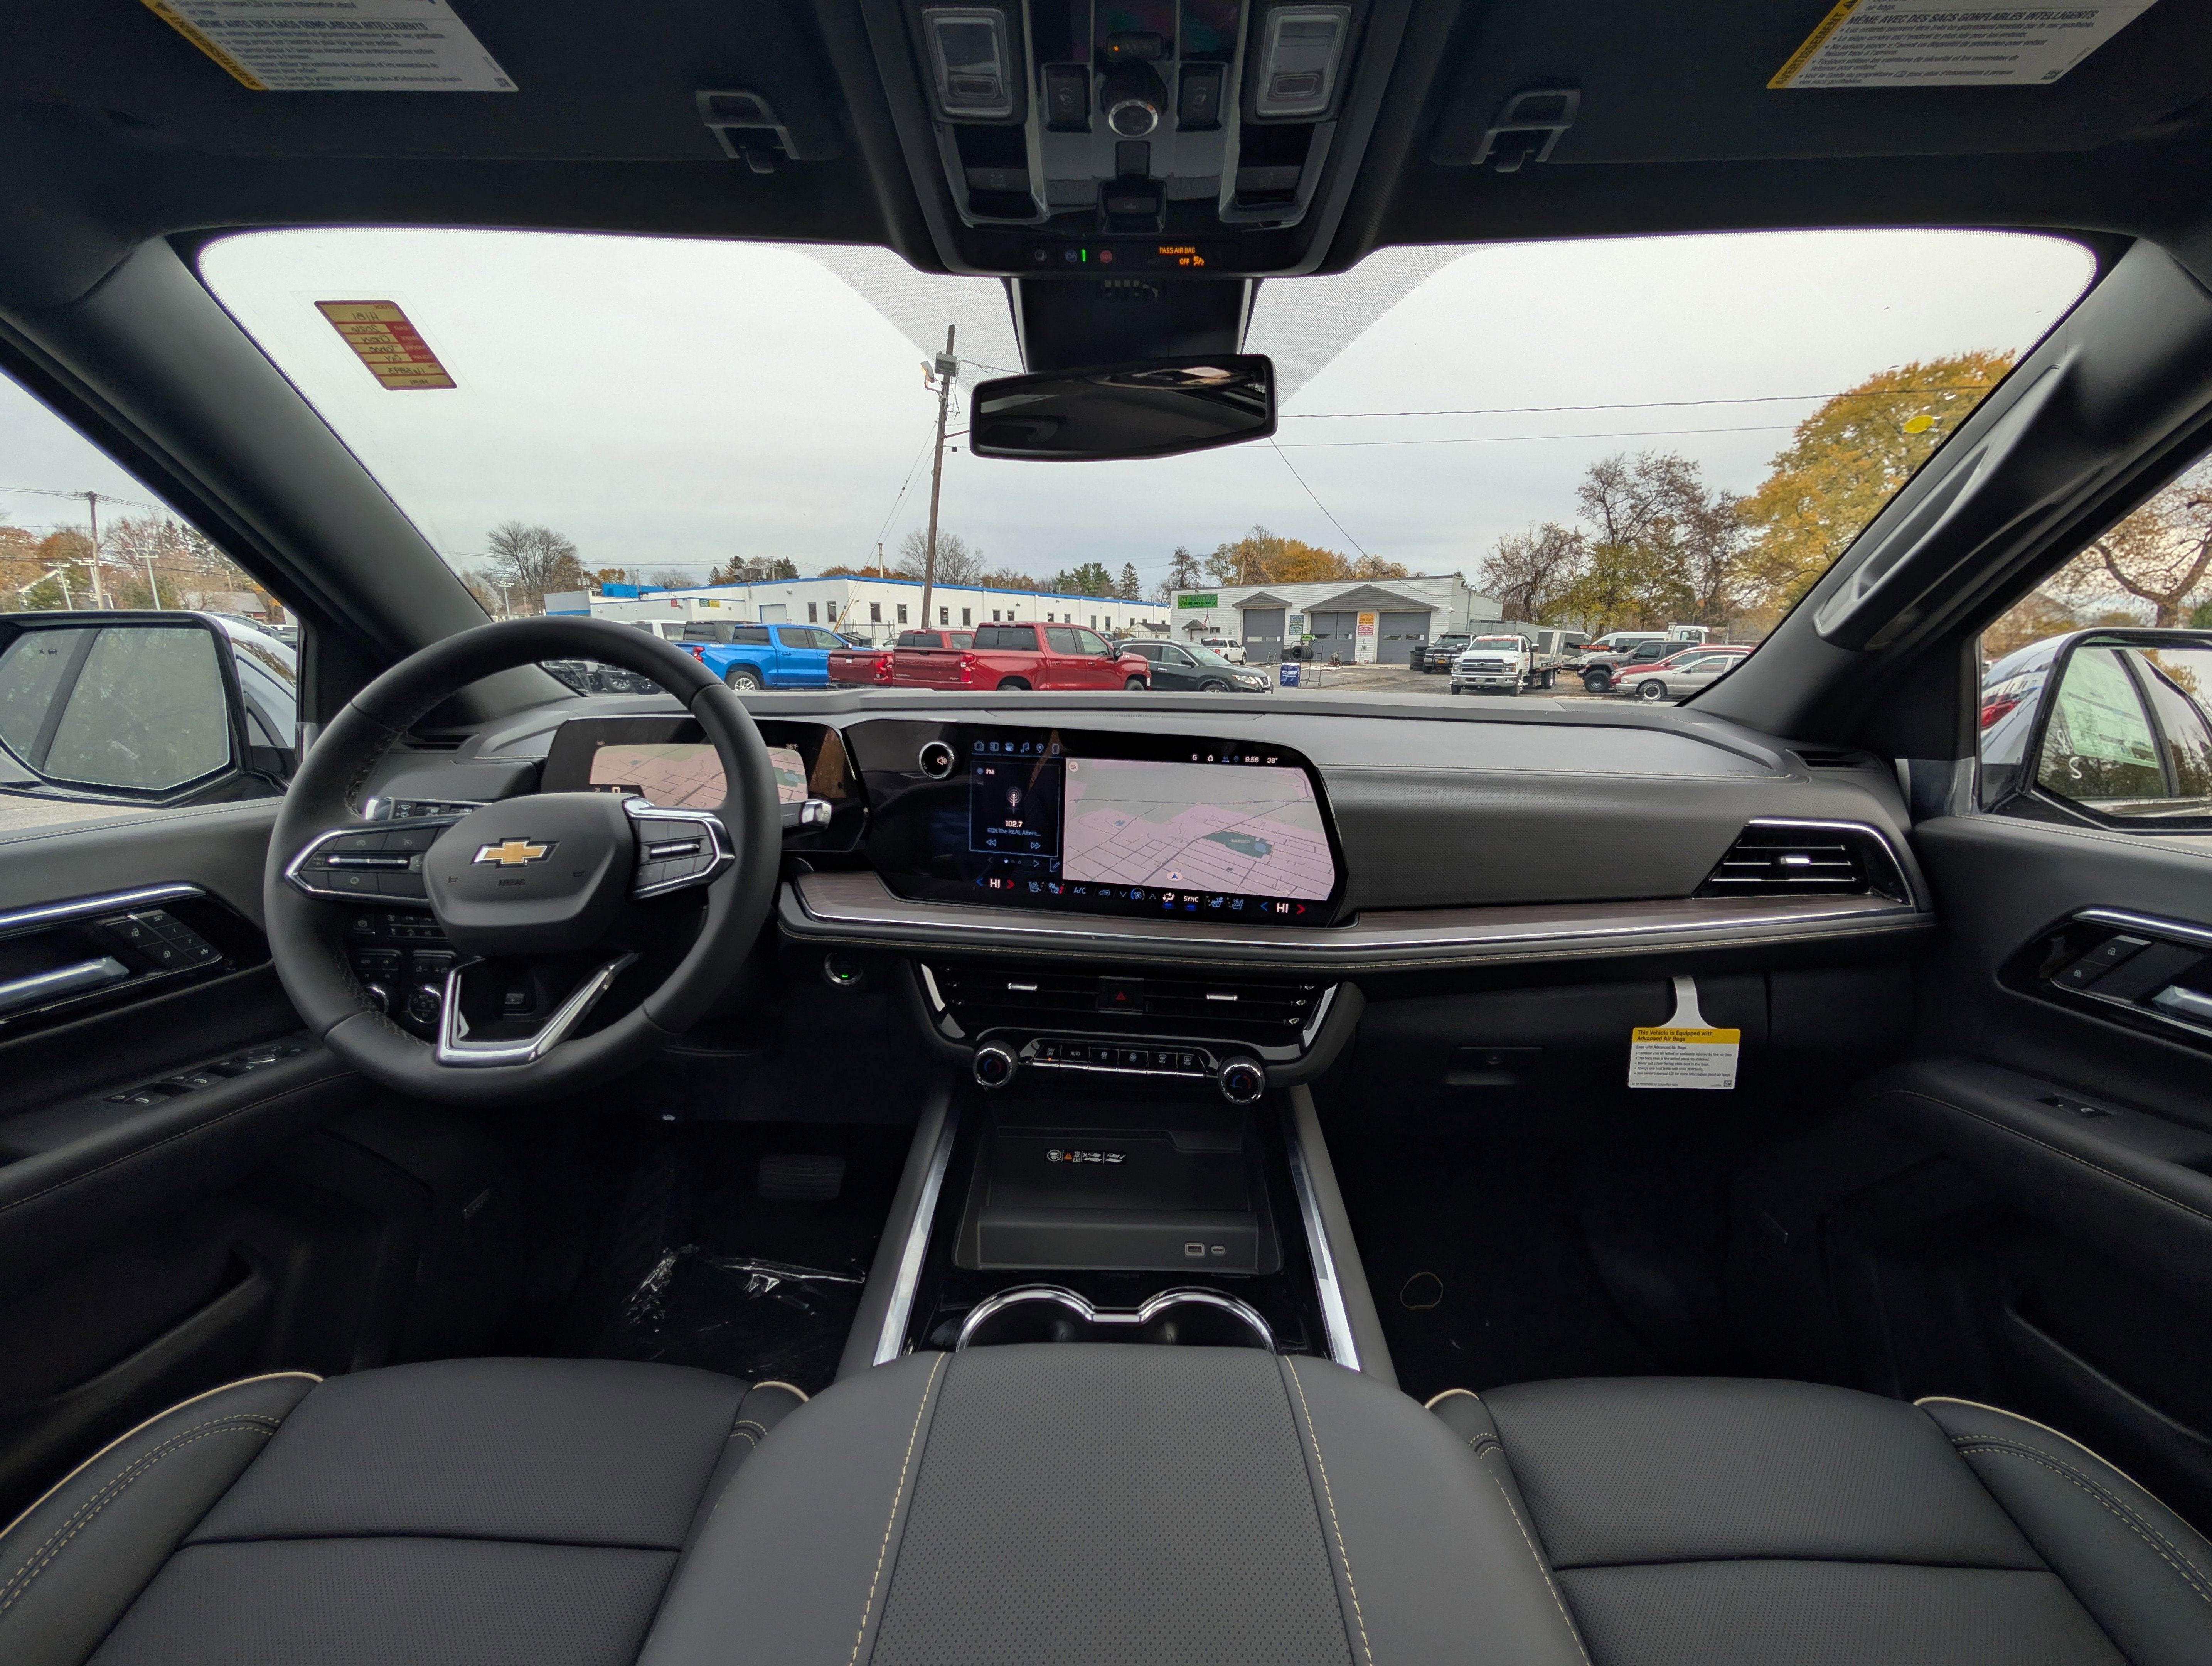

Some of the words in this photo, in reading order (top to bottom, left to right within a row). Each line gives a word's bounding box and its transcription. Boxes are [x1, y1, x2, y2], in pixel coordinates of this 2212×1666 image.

[1878, 14, 1909, 24] AVEC
[1906, 14, 1931, 23] DES
[1928, 13, 1960, 22] SACS
[1958, 12, 2027, 21] GONFLABLES
[2024, 10, 2099, 20] INTELLIGENTS
[1775, 12, 1845, 85] AVERTISSEMENT
[990, 879, 1000, 888] HI
[1276, 903, 1289, 913] HI
